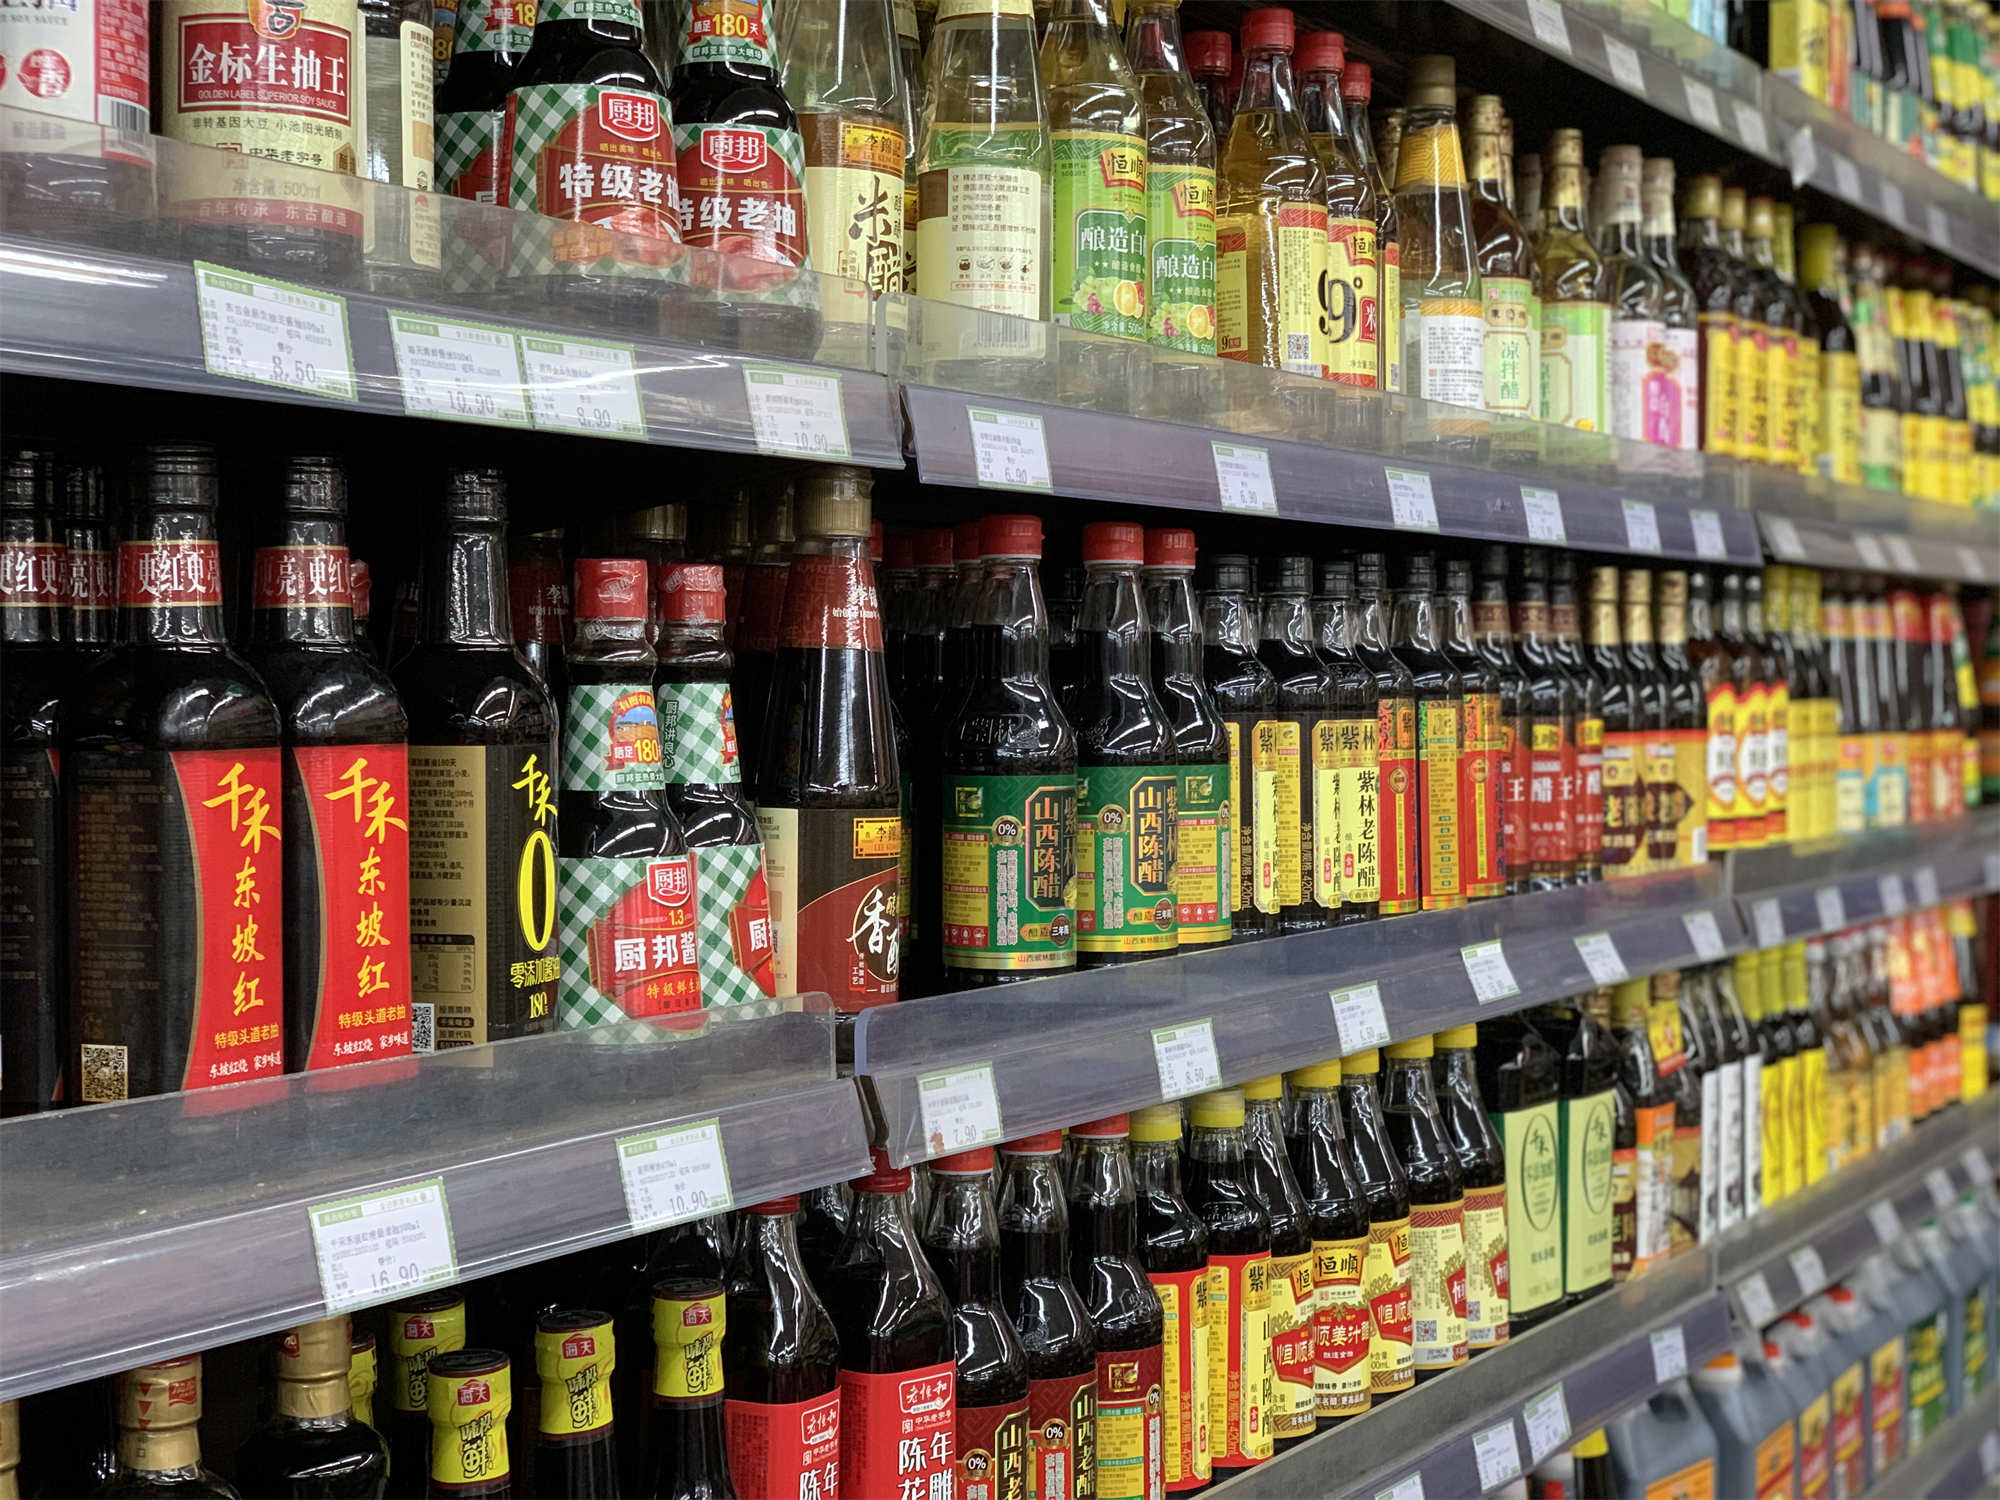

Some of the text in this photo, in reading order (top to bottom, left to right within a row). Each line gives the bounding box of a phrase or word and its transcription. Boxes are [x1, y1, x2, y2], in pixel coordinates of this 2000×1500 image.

[693, 13, 760, 37] 晒足180天
[187, 42, 346, 98] 金标生抽王
[198, 90, 337, 110] GOLDEN LABEL SUPERIOR SOY SAUCE
[608, 98, 655, 132] 厨邦
[709, 135, 760, 164] 厨邦
[1080, 226, 1146, 256] 酿造白
[1156, 254, 1216, 281] 酿造白
[272, 355, 316, 383] 8.50
[663, 700, 679, 769] 厨邦讲良心
[1259, 726, 1277, 753] 紫
[1319, 725, 1339, 753] 紫
[1340, 725, 1376, 751] 紫林
[324, 757, 409, 844] 千禾
[512, 754, 559, 827] 千禾
[1507, 777, 1525, 802] 王
[1531, 776, 1574, 803] 醋王
[202, 762, 282, 854] 千禾
[1103, 813, 1122, 824] 0%
[998, 824, 1016, 835] 0%
[1138, 786, 1164, 884] 山西陈醋
[1357, 769, 1376, 888] 紫林老陈醋
[1034, 797, 1060, 898] 山西陈醋
[517, 830, 556, 951] 0
[654, 867, 687, 896] 厨邦
[356, 846, 391, 999] 东坡红
[669, 909, 685, 926] 1.3
[232, 857, 265, 1017] 东坡红
[749, 917, 771, 953] 厨
[614, 931, 697, 974] 厨邦酱
[646, 978, 701, 1000] 特级鲜生
[338, 1005, 407, 1029] 特级头道老抽
[214, 1023, 280, 1049] 特级头道老抽
[333, 1037, 374, 1057] 东坡红烧
[209, 1057, 249, 1079] 东坡红烧
[669, 1190, 708, 1215] 10.90
[1395, 1232, 1409, 1252] 恒
[371, 1263, 420, 1289] 16.90
[1315, 1253, 1361, 1276] 恒順
[1248, 1265, 1268, 1294] 紫
[685, 1309, 711, 1325] 海天
[1378, 1302, 1412, 1325] 恒顺
[406, 1322, 432, 1338] 海天
[565, 1340, 594, 1357] 海天
[684, 1331, 713, 1394] 味极鲜
[460, 1386, 489, 1405] 海天
[565, 1363, 599, 1429] 味极鲜
[459, 1411, 493, 1479] 味极鲜
[1046, 1427, 1063, 1439] 0%
[899, 1431, 954, 1475] 陈年
[968, 1458, 987, 1470] 0%
[799, 1461, 839, 1500] 陈年
